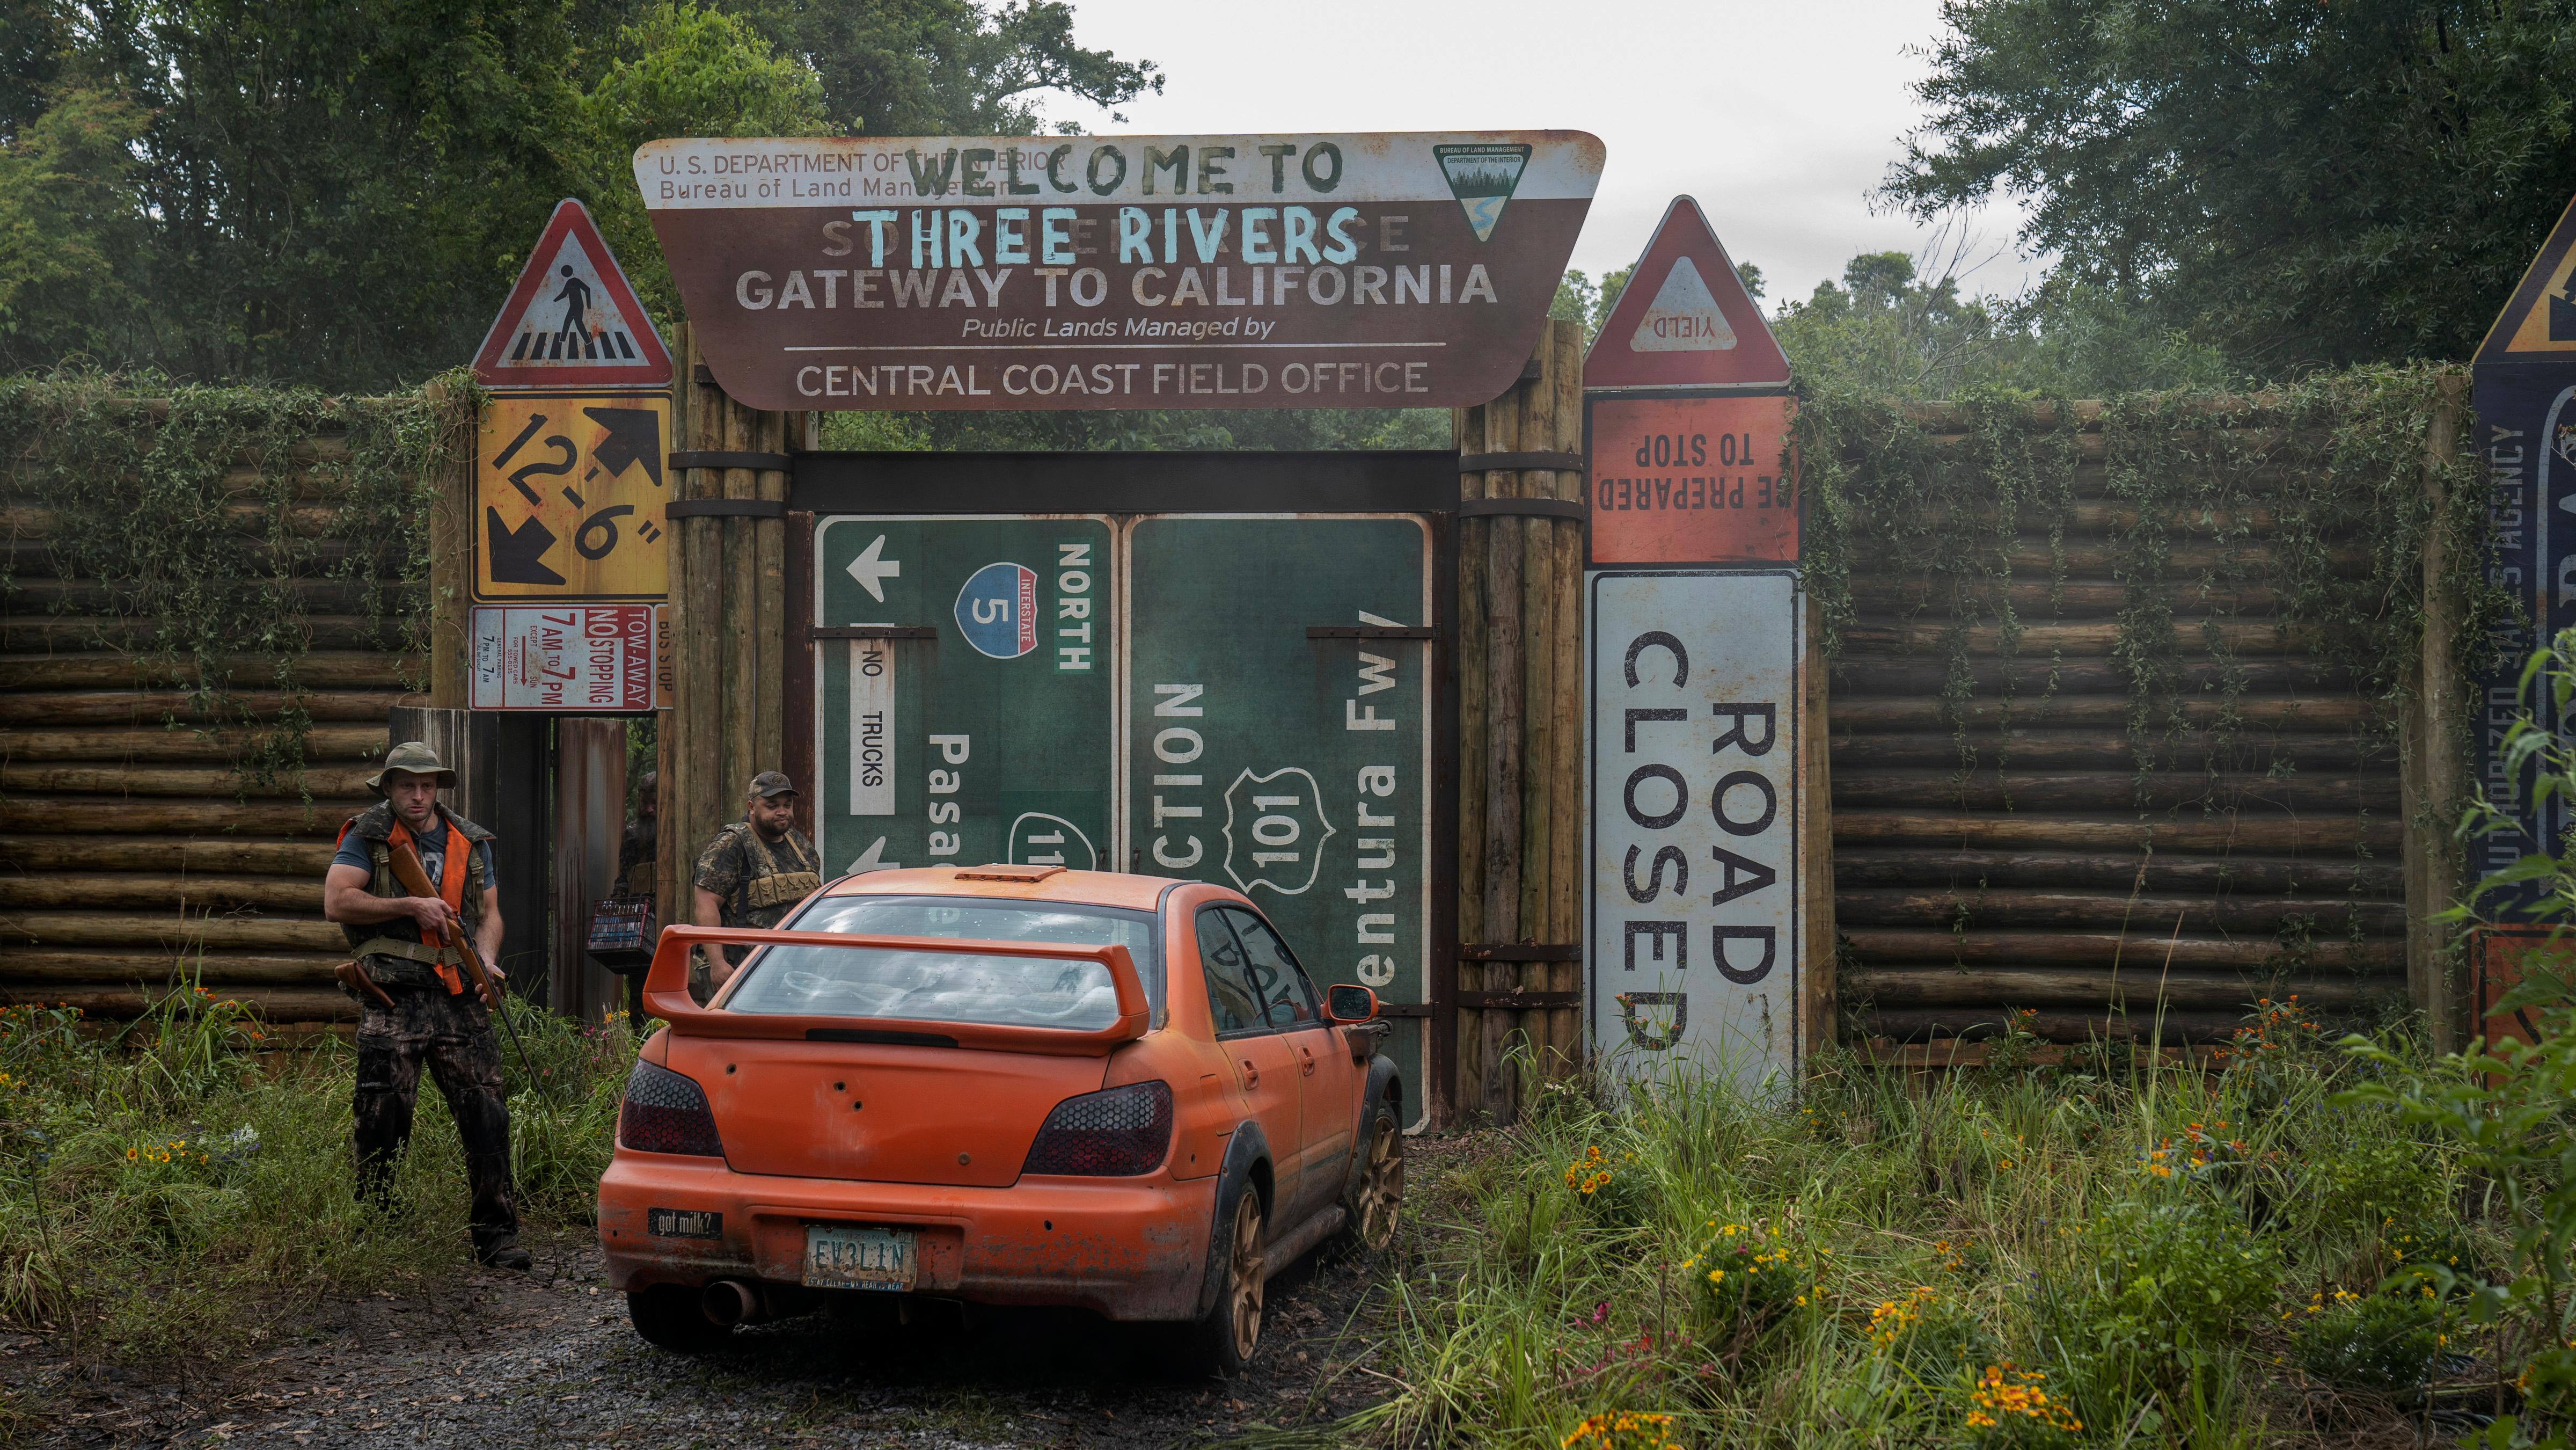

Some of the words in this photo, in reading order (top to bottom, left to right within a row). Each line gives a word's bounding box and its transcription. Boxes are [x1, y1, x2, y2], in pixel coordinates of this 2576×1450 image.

[714, 154, 864, 174] DEPARTMENT
[874, 153, 903, 172] OF
[905, 144, 1234, 197] WELCOME
[1258, 142, 1343, 194] TO
[660, 180, 748, 200] Bureau
[758, 179, 780, 199] of
[793, 178, 851, 197] Land
[852, 207, 1077, 268] THREE
[1119, 206, 1358, 265] RIVERS
[736, 268, 1013, 311] GATEWAY
[1034, 267, 1108, 308] TO
[1132, 264, 1498, 307] CALIFORNIA
[962, 319, 1035, 338] Public
[1044, 318, 1117, 338] Lands
[1125, 317, 1238, 338] Managed
[1244, 317, 1276, 340] by
[1654, 316, 1715, 339] YIELD
[796, 365, 991, 397] CENTRAL
[1003, 364, 1140, 396] COAST
[1153, 363, 1268, 395] FIELD
[1282, 362, 1429, 395] OFFICE
[1636, 434, 1707, 468] STOP
[1721, 433, 1754, 467] TO
[1598, 477, 1744, 511] PREPARED
[542, 613, 575, 626] 7
[588, 609, 618, 636] NO
[972, 598, 1008, 622] 5
[1021, 579, 1030, 643] INTERSTATE
[1059, 544, 1091, 669] NORTH
[483, 643, 489, 652] PM
[542, 628, 562, 650] AM
[659, 621, 670, 649] BUS
[542, 667, 575, 680] 7
[548, 655, 560, 666] TO
[589, 640, 614, 703] STOPPING
[627, 610, 647, 704] TOW-AWAY
[862, 651, 883, 677] NO
[482, 674, 489, 683] AM
[541, 682, 562, 704] PM
[862, 710, 883, 786] TRUCKS
[1153, 684, 1204, 882] CTION
[929, 734, 970, 868] Pasa
[1252, 796, 1300, 868] 101
[1624, 631, 1689, 1051] CLOSED
[1713, 703, 1777, 984] ROAD
[1344, 766, 1395, 987] entura
[658, 1211, 676, 1235] got
[679, 1212, 712, 1235] milk?
[832, 1233, 889, 1241] ARIZONA
[816, 1240, 904, 1272] EV3L1N
